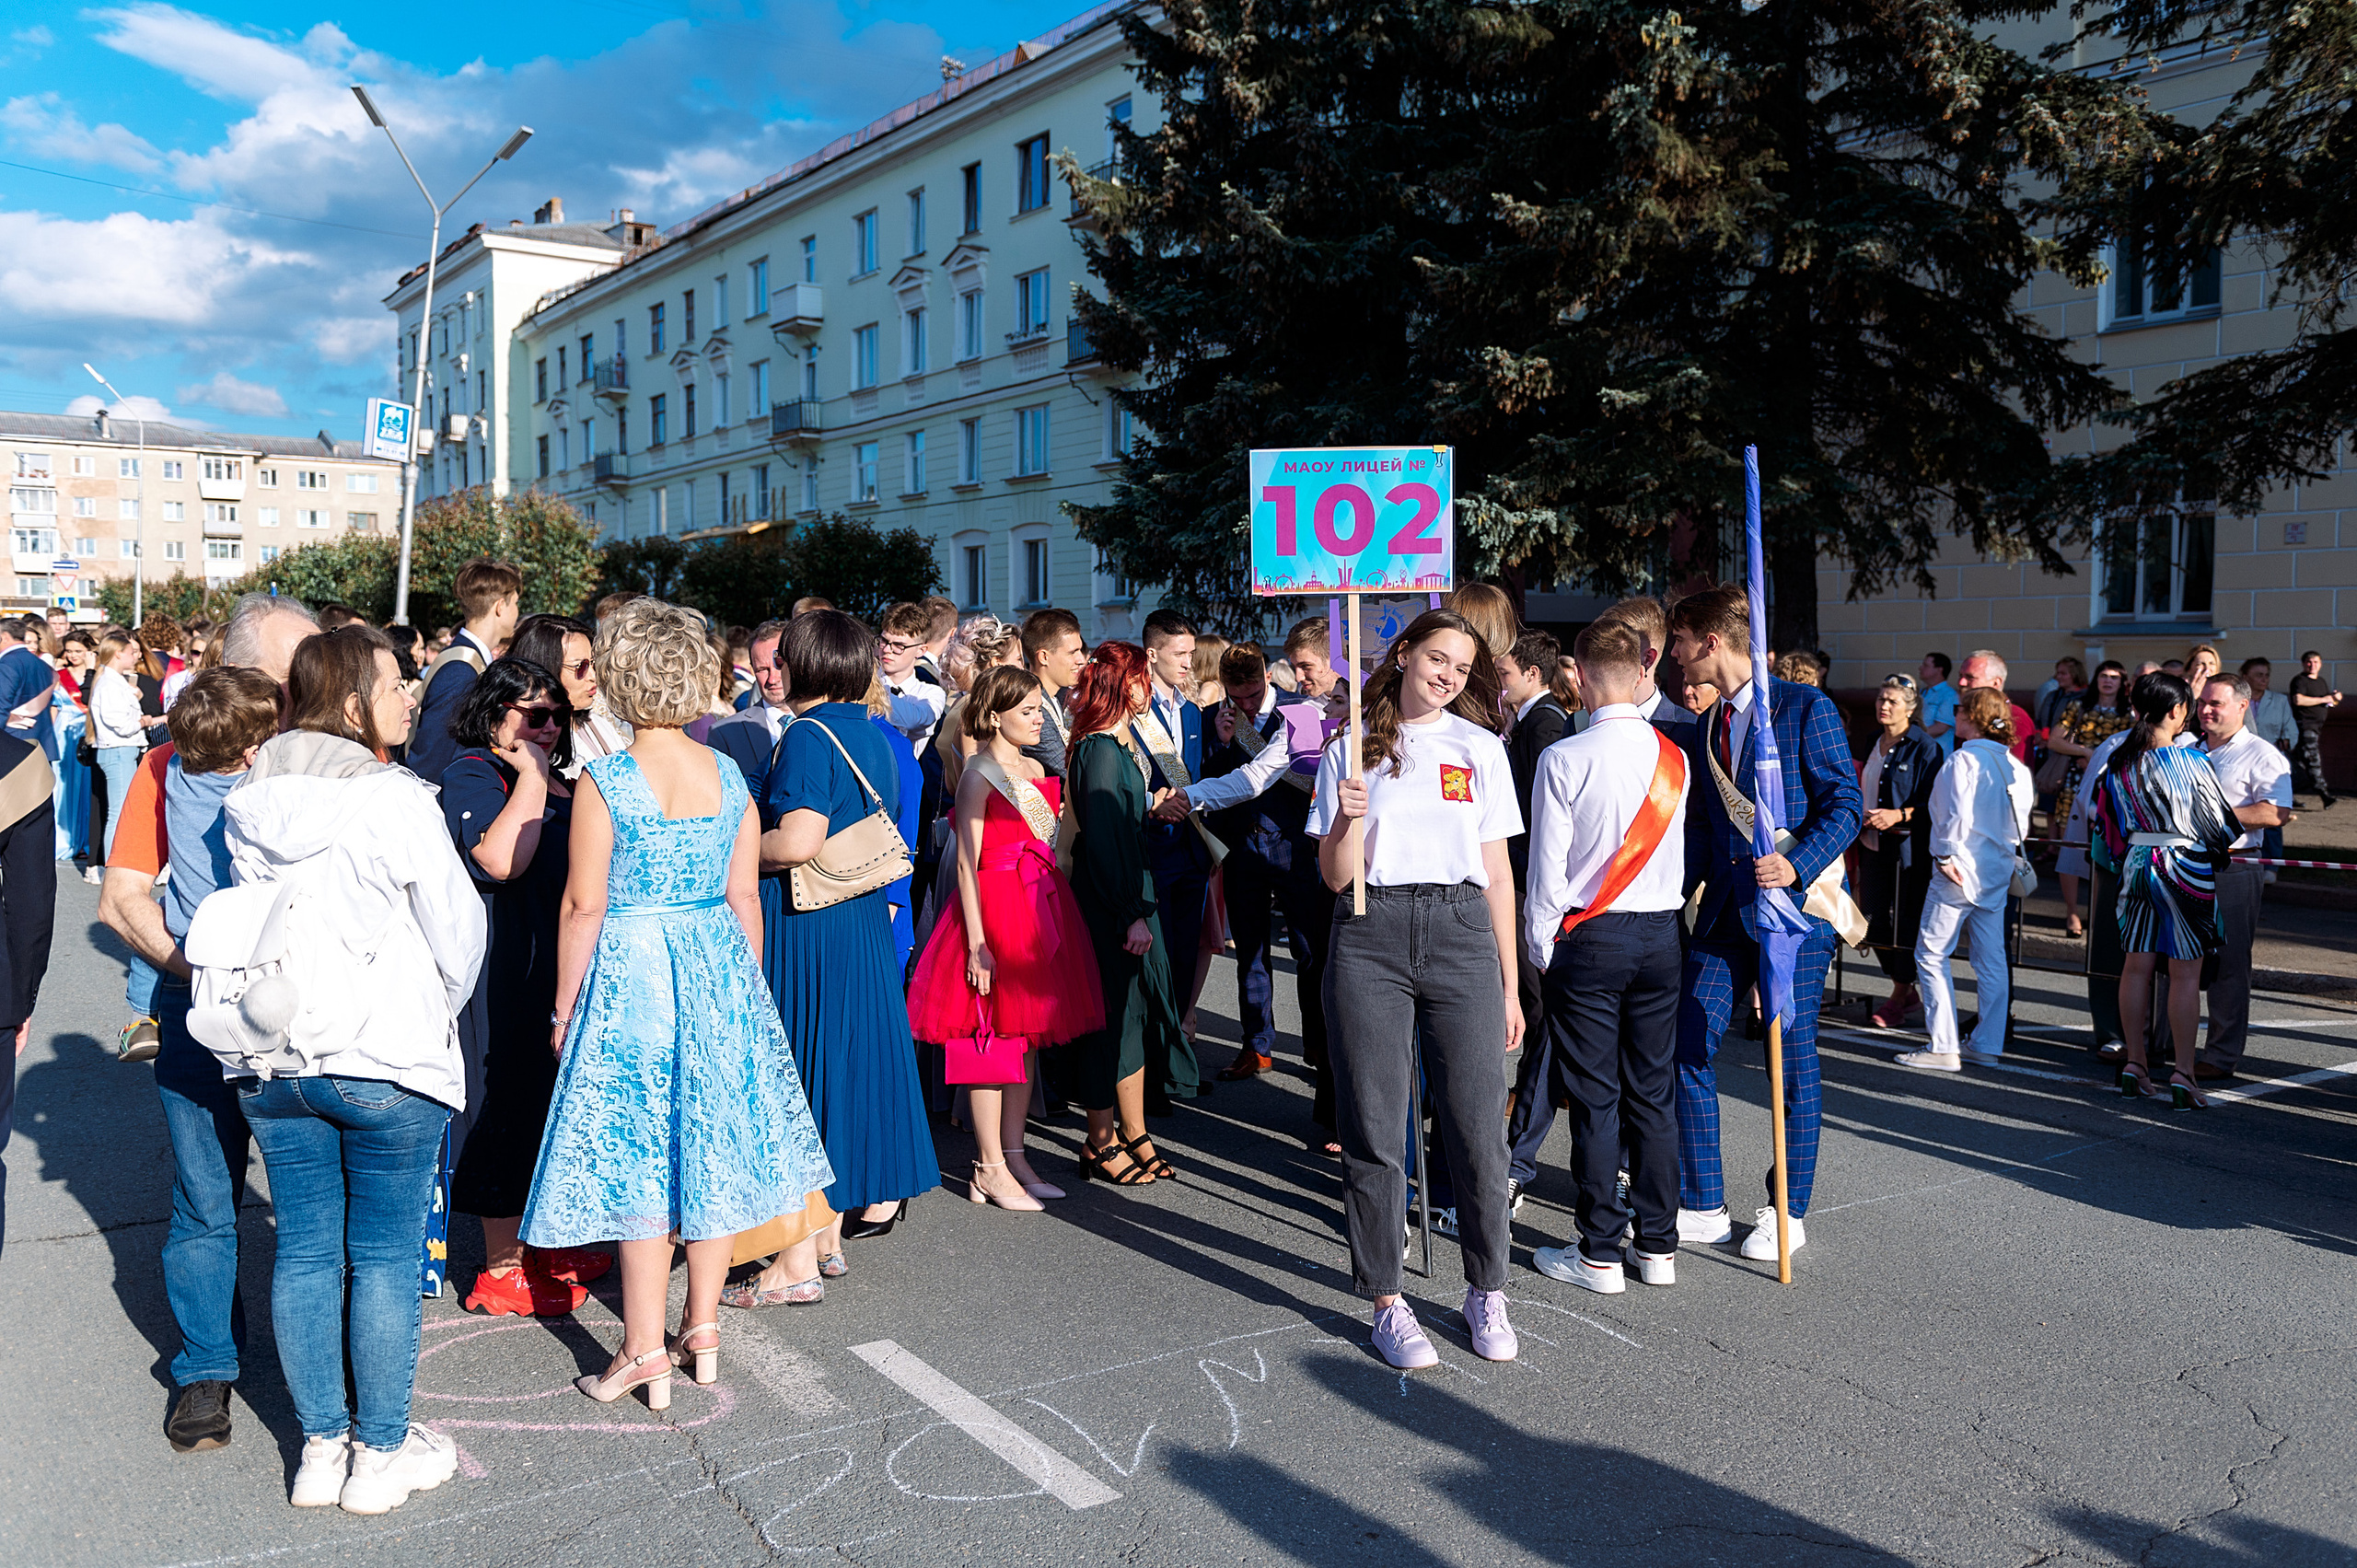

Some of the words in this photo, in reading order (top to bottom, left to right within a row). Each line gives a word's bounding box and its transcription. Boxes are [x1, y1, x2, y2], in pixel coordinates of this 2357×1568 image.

[1284, 461, 1335, 473] МАОУ
[1341, 458, 1402, 474] ЛИЦЕЙ
[1409, 459, 1426, 471] №
[1262, 482, 1443, 556] 102
